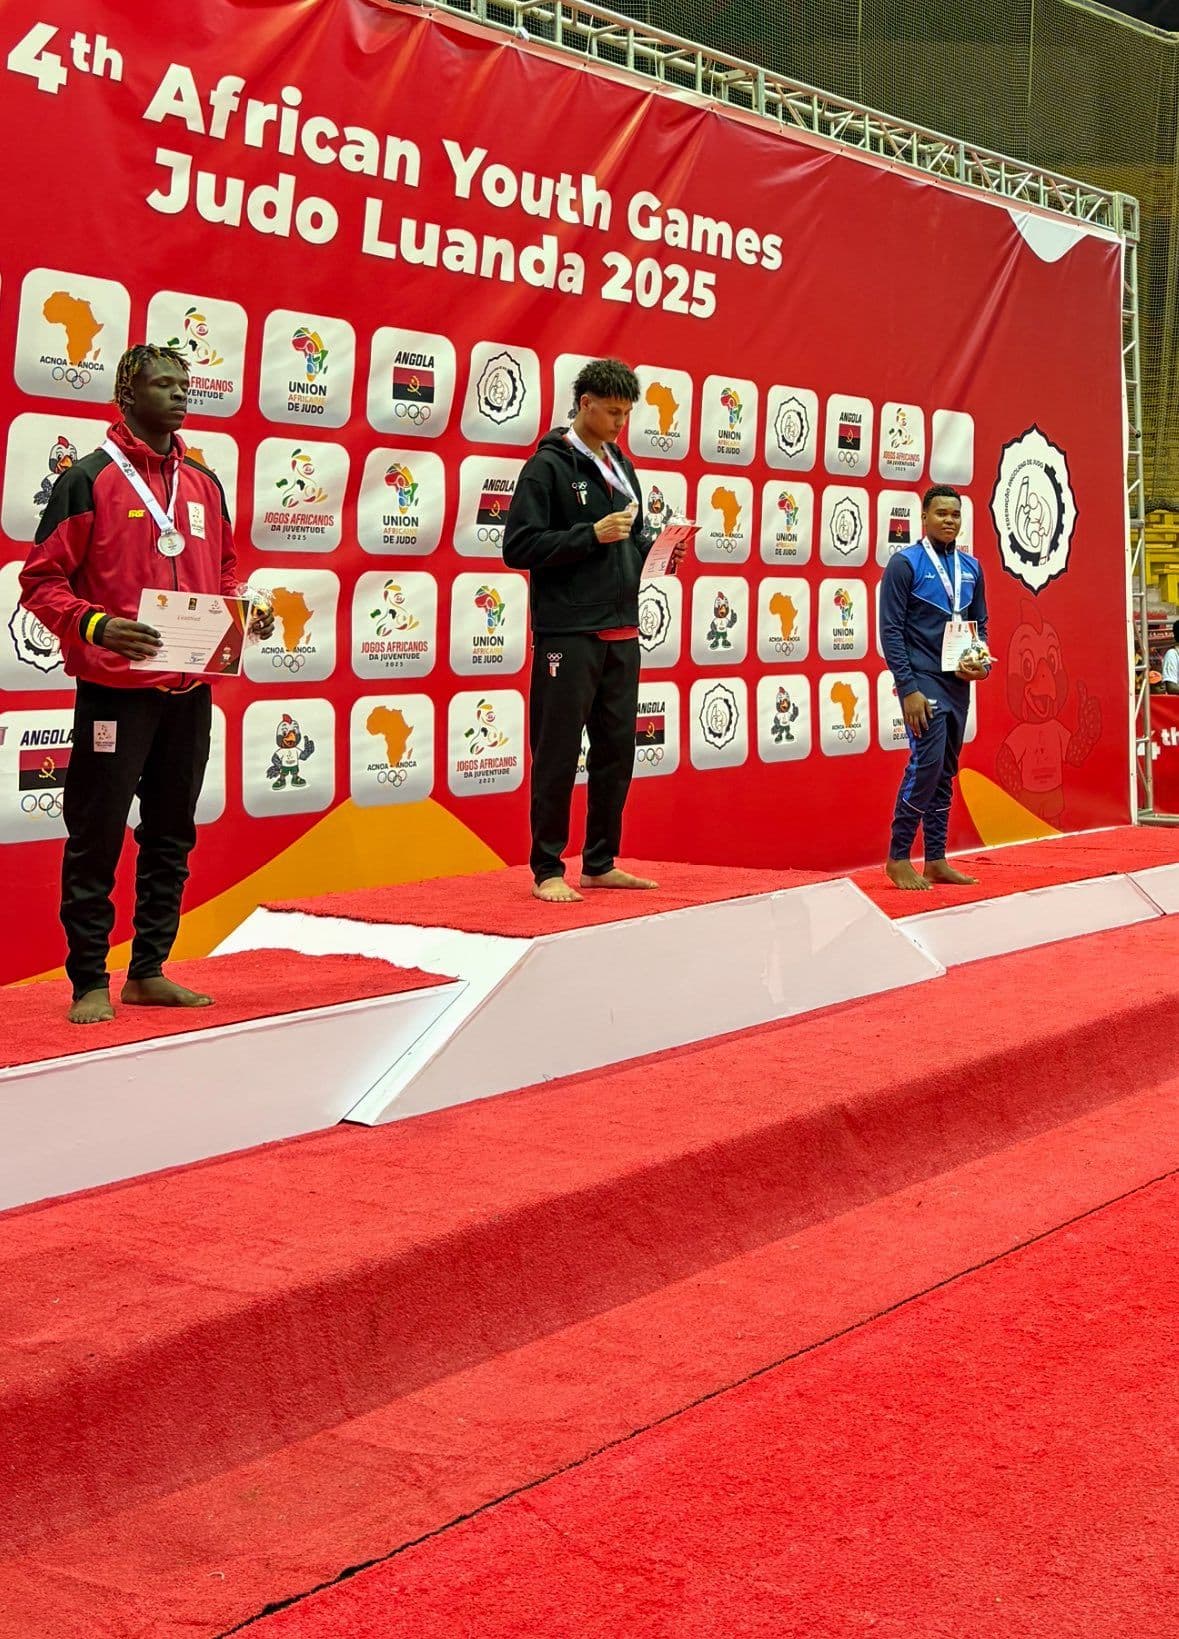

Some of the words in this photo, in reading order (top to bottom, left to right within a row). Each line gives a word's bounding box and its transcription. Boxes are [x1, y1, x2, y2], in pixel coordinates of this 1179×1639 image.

[7, 22, 123, 94] 4th
[143, 63, 420, 187] African
[443, 140, 611, 230] Youth
[628, 191, 782, 270] Games
[146, 148, 338, 243] Judo
[362, 197, 584, 294] Luanda
[602, 252, 716, 318] 2025
[40, 356, 67, 366] ACNOA
[77, 361, 104, 371] ANOCA
[394, 351, 434, 368] ANGOLA
[190, 376, 234, 393] FRICANOS
[289, 381, 327, 396] UNION
[287, 402, 300, 412] DE
[301, 404, 324, 414] JUDO
[839, 412, 862, 424] ANGOLA
[718, 429, 741, 441] UNION
[717, 446, 725, 454] DE
[725, 447, 741, 455] JUDO
[482, 478, 515, 492] ANGOLA
[890, 507, 910, 517] ANGOLA
[264, 512, 290, 524] JOGOS
[290, 513, 334, 527] AFRICANOS
[383, 515, 419, 527] UNION
[270, 524, 281, 532] DA
[282, 525, 326, 534] JUVENTUDE
[383, 535, 395, 544] DE
[395, 536, 417, 545] JUDO
[776, 533, 797, 542] UNION
[832, 628, 854, 637] UNION
[361, 642, 386, 654] JOGOS
[386, 641, 428, 652] AFRICANOS
[473, 636, 504, 647] UNION
[368, 653, 379, 661] DA
[380, 653, 420, 661] JUVENTUDE
[472, 655, 482, 664] DE
[483, 655, 503, 664] JUDO
[367, 763, 389, 771] ACNOA
[456, 759, 479, 772] JOGOS
[479, 756, 517, 770] AFRICANOS
[474, 768, 510, 778] JUVENTUDE
